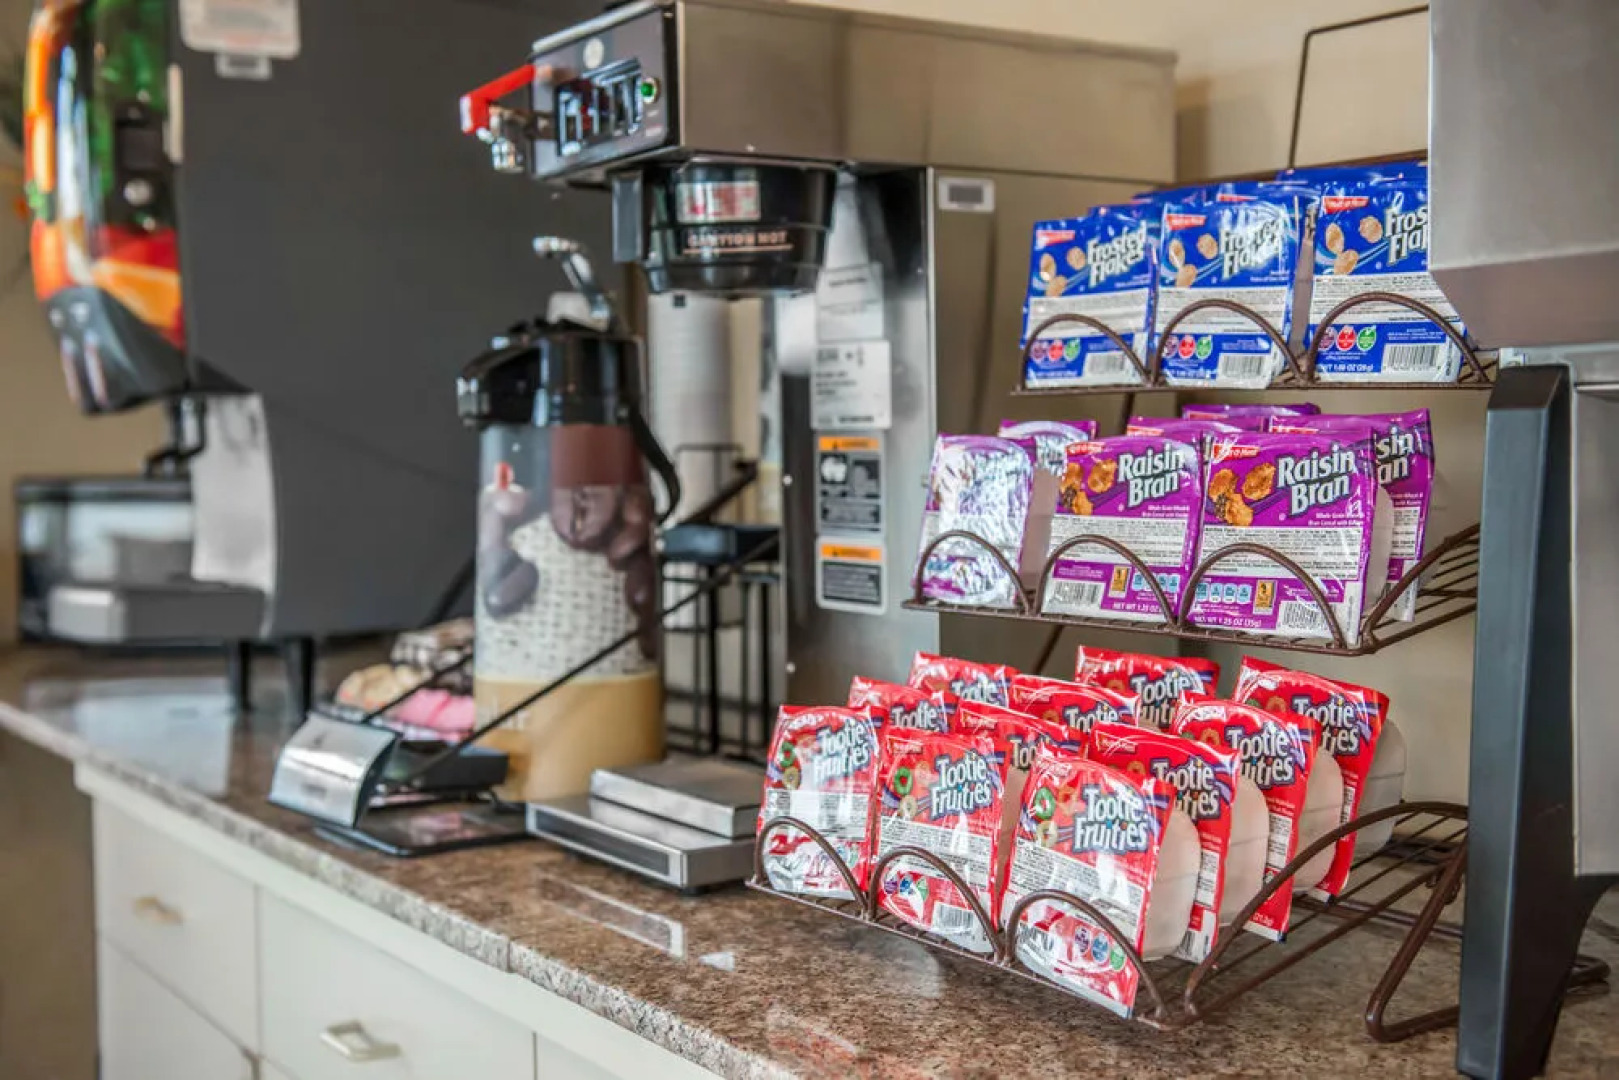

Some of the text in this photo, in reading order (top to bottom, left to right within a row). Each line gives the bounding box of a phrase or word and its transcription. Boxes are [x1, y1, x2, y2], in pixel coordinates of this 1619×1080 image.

[1386, 206, 1427, 237] Fros
[1087, 219, 1146, 265] Frosted
[1389, 225, 1427, 265] Fla
[1090, 254, 1140, 288] Flakes
[1377, 426, 1414, 458] sin
[1117, 442, 1184, 482] Raisin
[1276, 441, 1354, 488] Raisin
[1377, 454, 1409, 484] an
[1128, 470, 1179, 508] Bran
[1290, 473, 1350, 516] Bran
[1131, 670, 1190, 704] Tootie
[1064, 702, 1118, 733] Tootie
[1293, 692, 1355, 728] Tootie
[816, 718, 867, 757] Tootie
[1226, 720, 1290, 759] Tootie
[1322, 725, 1359, 756] ties
[935, 750, 987, 789] Tootie
[1150, 757, 1215, 792] Tootie
[931, 780, 992, 819] Fruities
[1082, 786, 1146, 822] Tootie
[1073, 815, 1149, 853] Fruities
